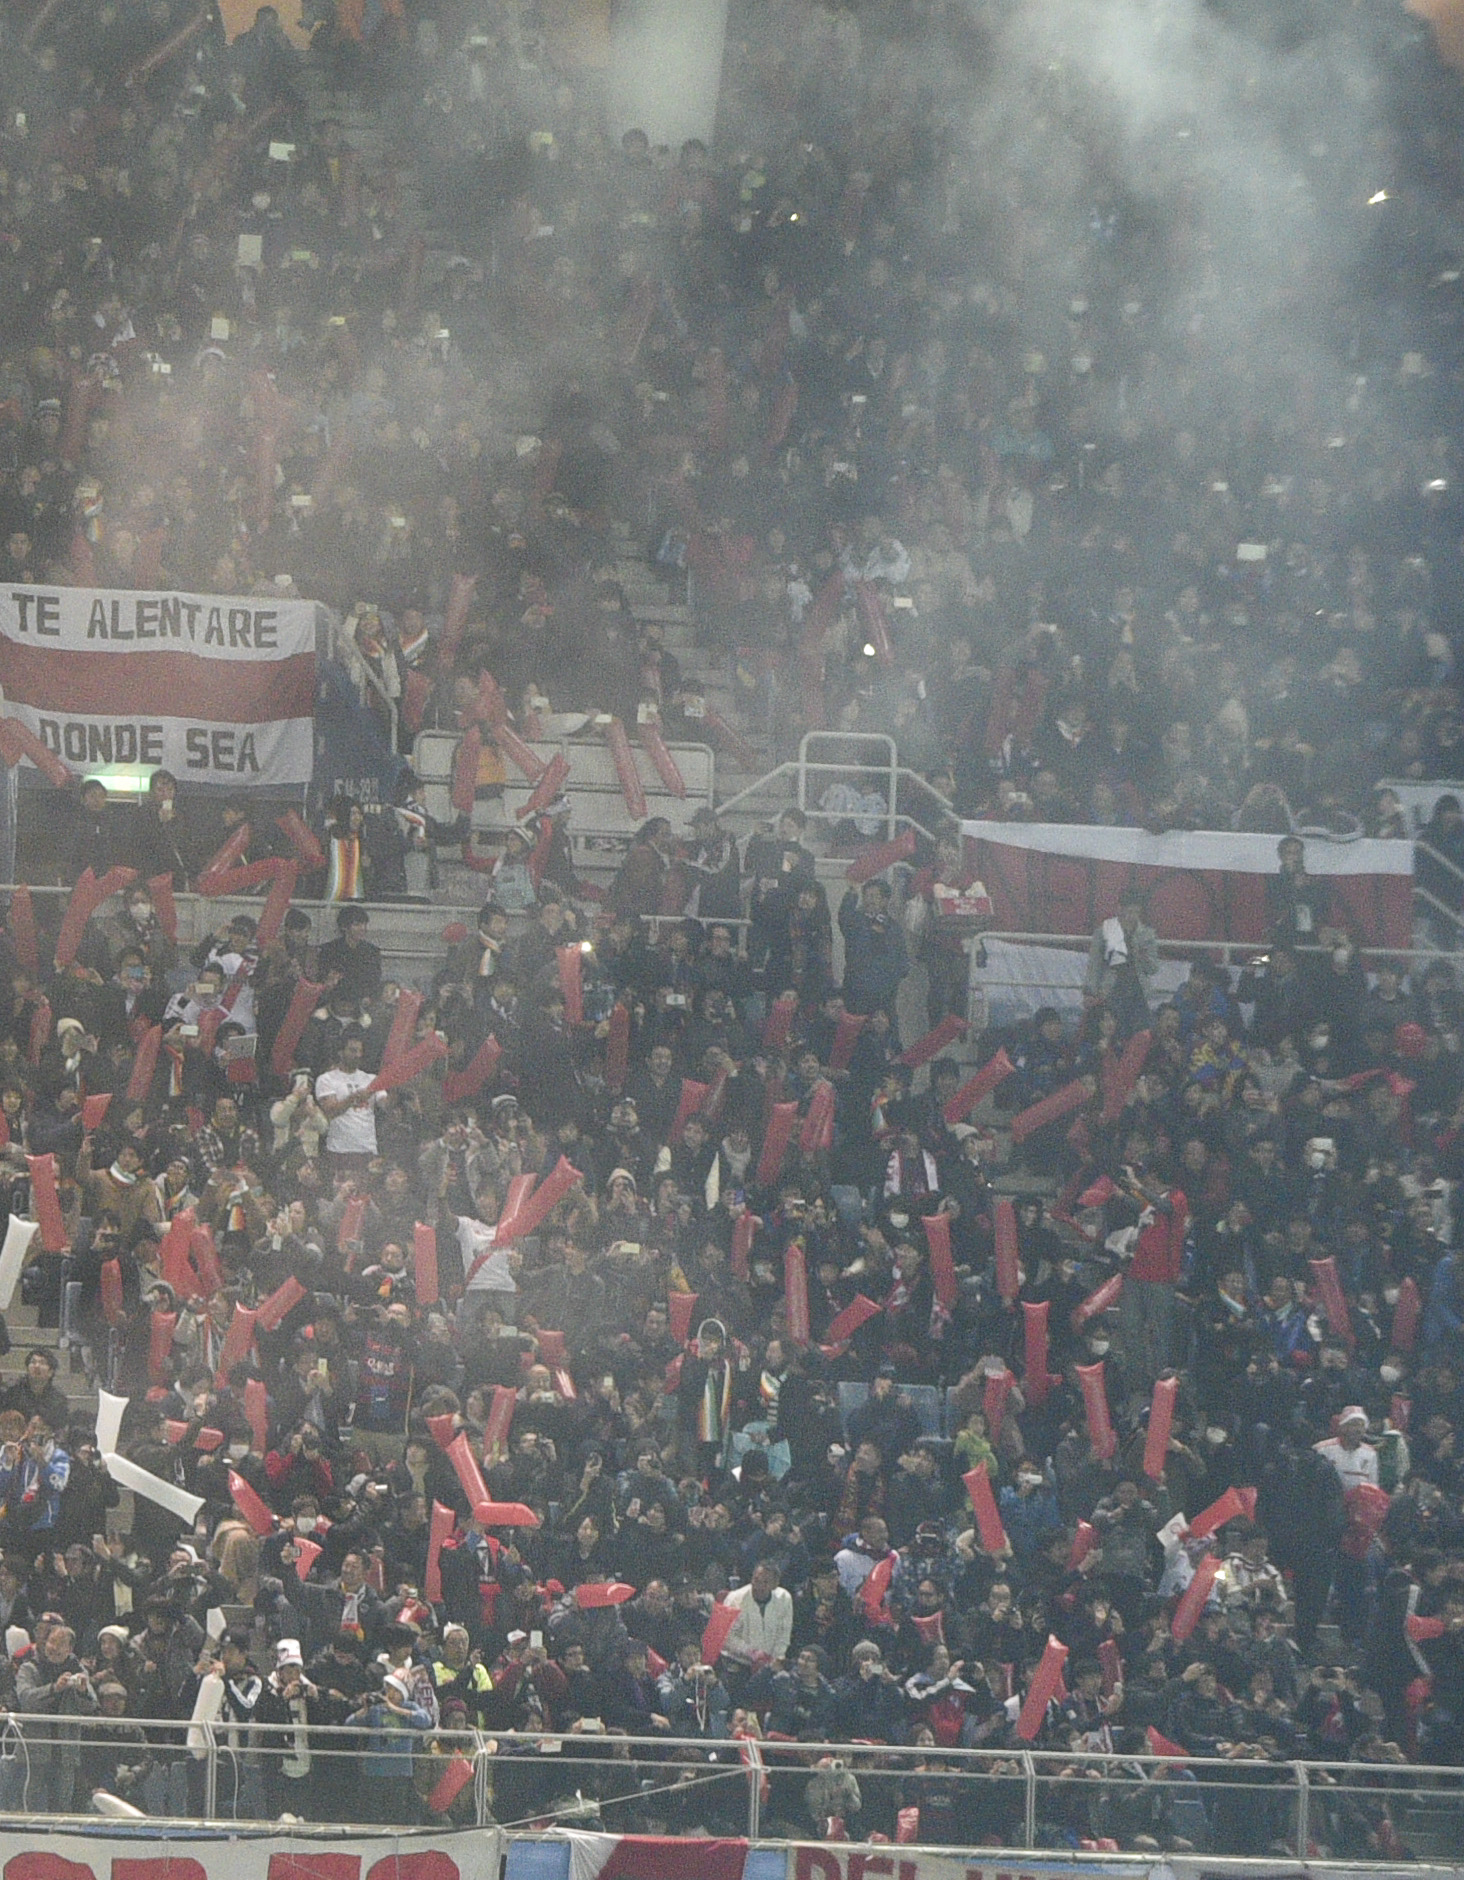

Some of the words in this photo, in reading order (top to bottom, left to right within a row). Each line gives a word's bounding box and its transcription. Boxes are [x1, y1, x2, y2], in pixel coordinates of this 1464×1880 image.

[11, 592, 61, 637] TE
[86, 596, 279, 650] ALENTARE
[186, 727, 261, 774] SEA
